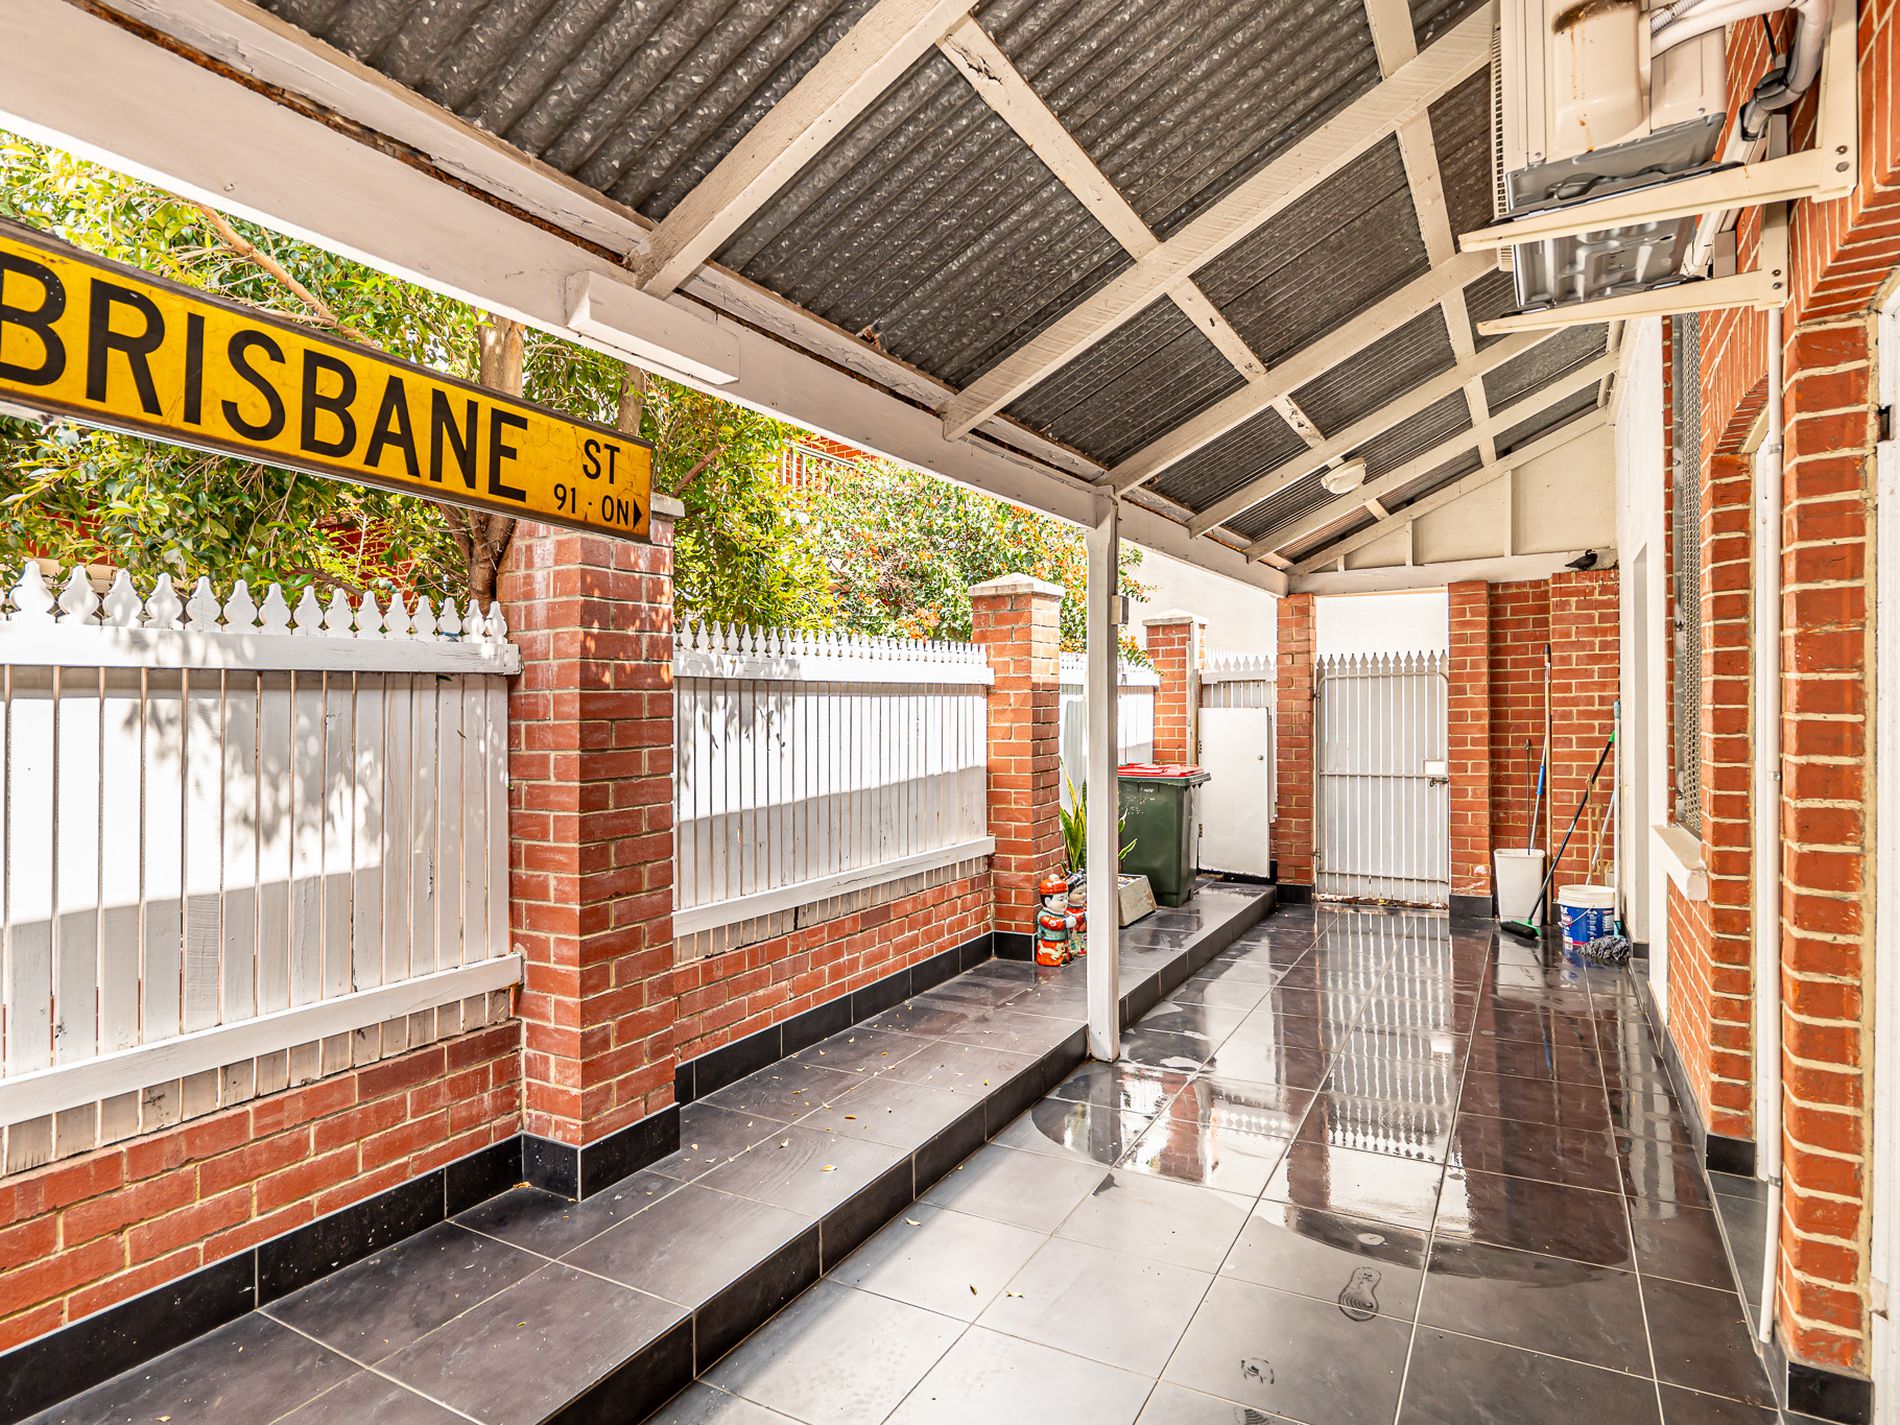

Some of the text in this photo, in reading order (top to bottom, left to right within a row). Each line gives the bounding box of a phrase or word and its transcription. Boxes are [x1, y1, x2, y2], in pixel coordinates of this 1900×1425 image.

[0, 252, 620, 503] BRISBANE ST
[554, 483, 576, 514] 91
[602, 495, 629, 526] ON
